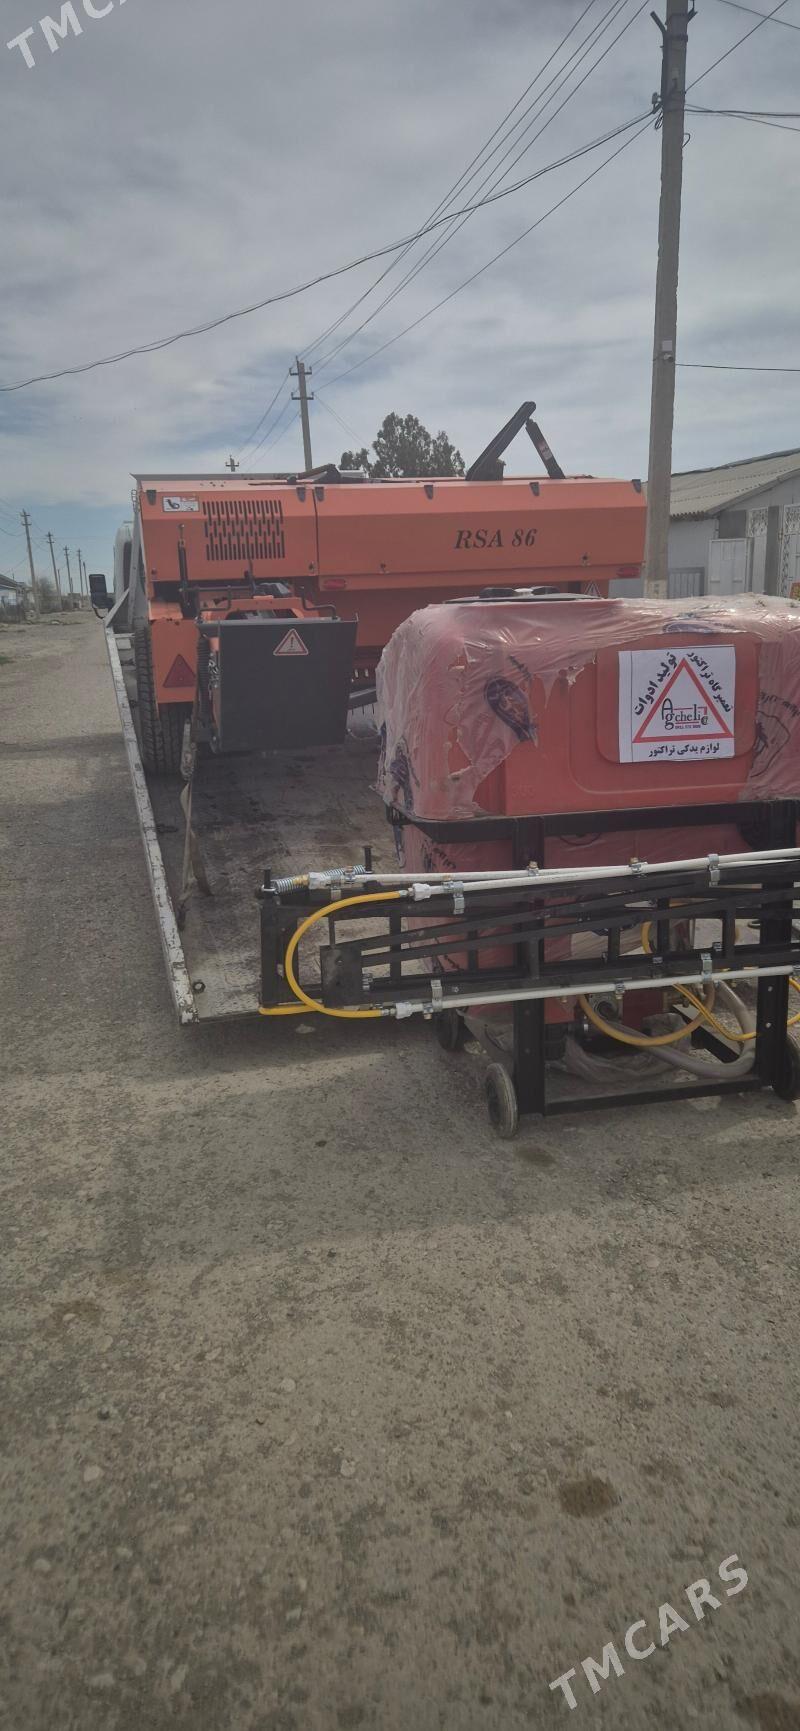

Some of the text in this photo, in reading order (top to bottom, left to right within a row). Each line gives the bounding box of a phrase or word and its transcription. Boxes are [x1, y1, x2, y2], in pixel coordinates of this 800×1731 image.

[454, 528, 538, 549] RSA 86
[686, 652, 714, 679] تراکتور
[634, 652, 677, 715] تولید ادوات
[648, 745, 676, 758] تراکتور
[700, 742, 720, 755] لوازم
